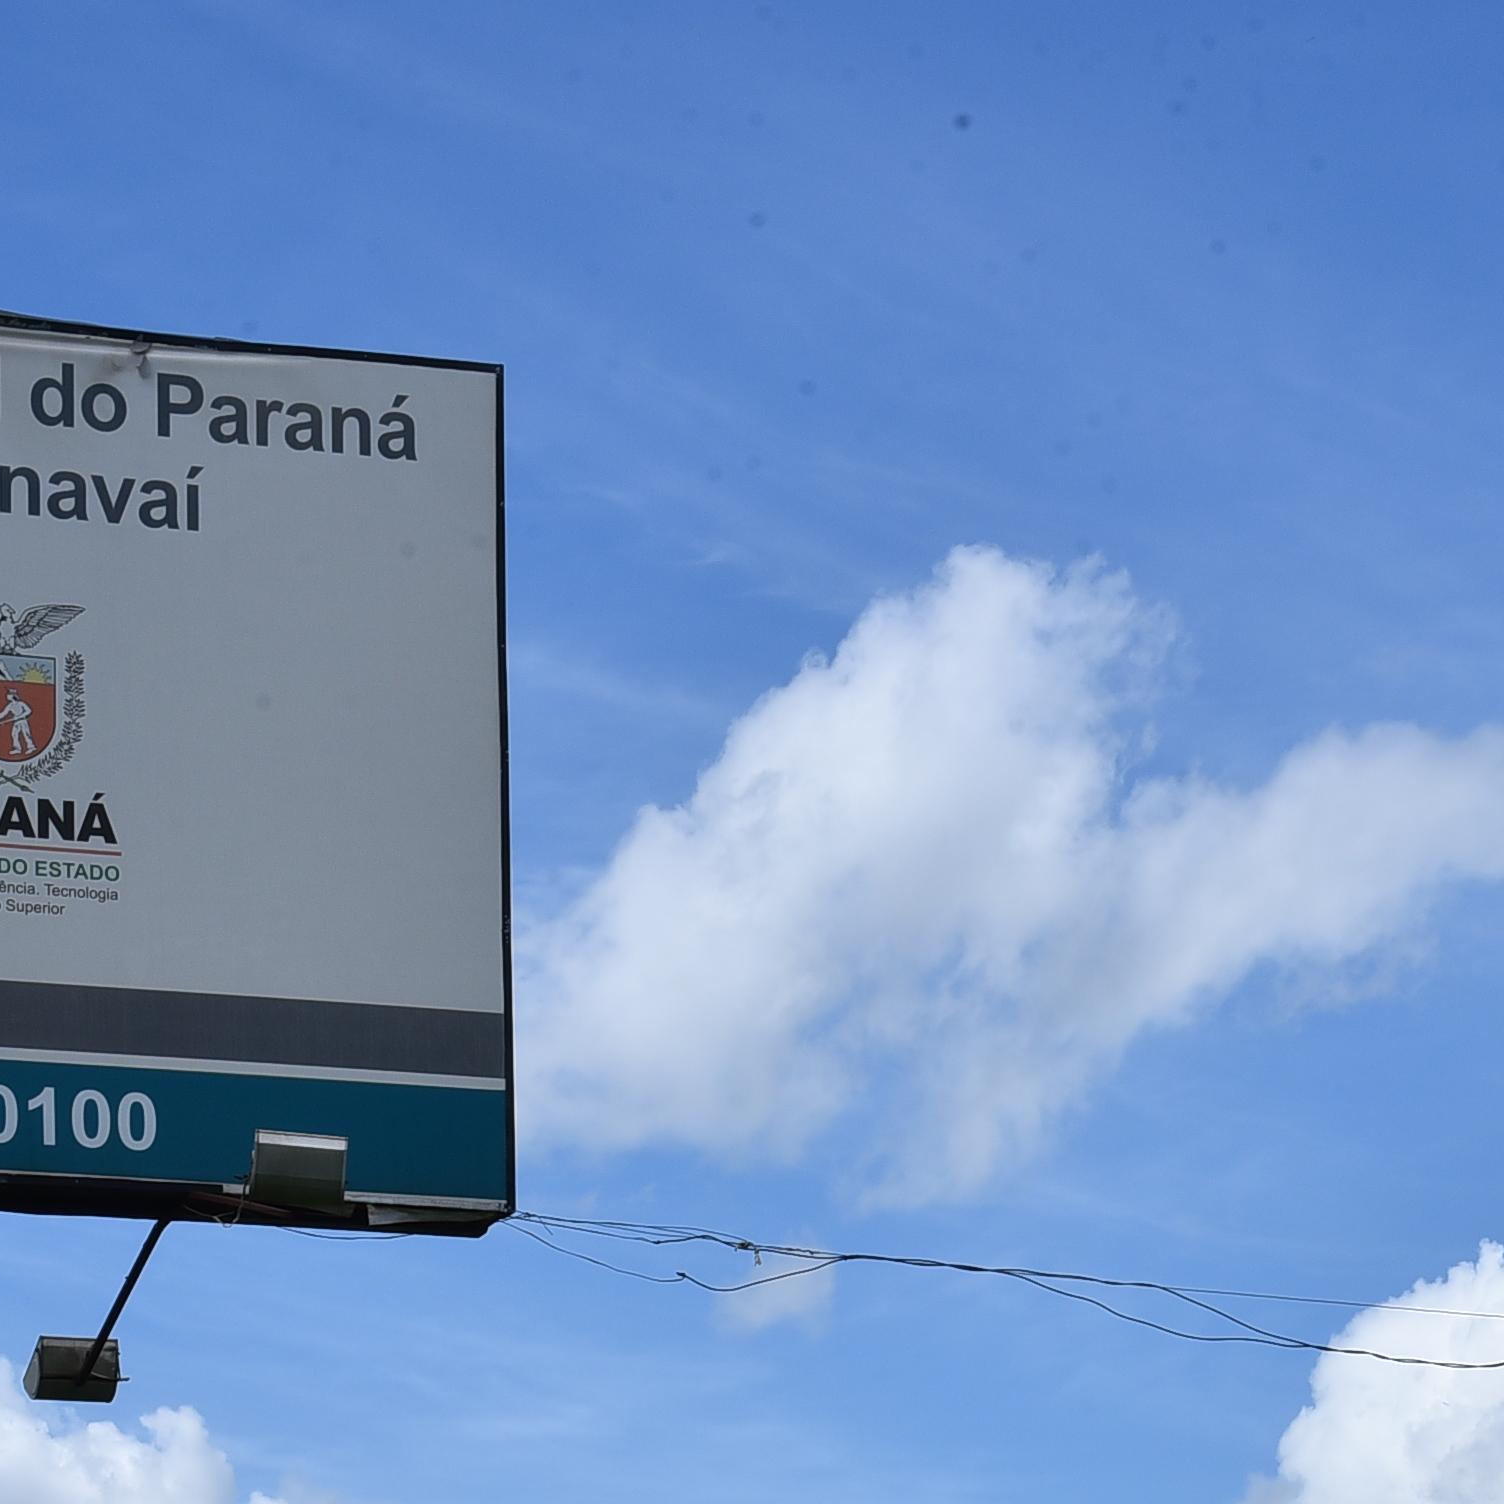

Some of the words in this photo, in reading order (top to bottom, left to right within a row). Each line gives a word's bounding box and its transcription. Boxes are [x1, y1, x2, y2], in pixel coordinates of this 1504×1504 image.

[29, 363, 128, 433] do
[156, 372, 417, 460] Paraná
[35, 860, 120, 882] ESTADO
[45, 884, 118, 903] Tecnologia
[5, 900, 65, 916] Superior
